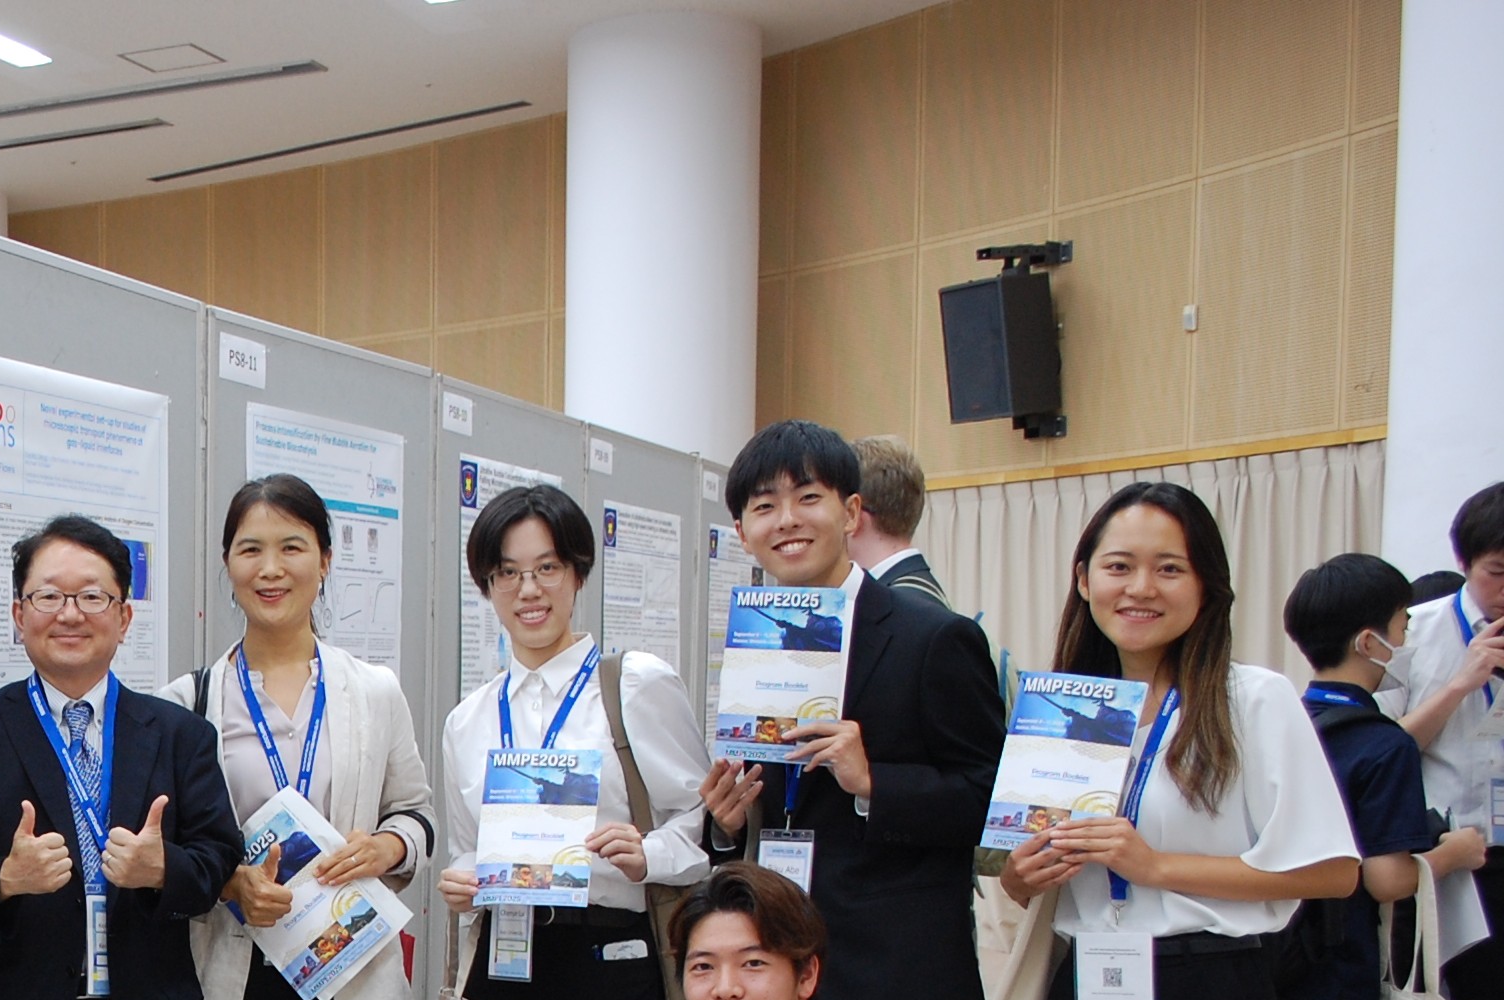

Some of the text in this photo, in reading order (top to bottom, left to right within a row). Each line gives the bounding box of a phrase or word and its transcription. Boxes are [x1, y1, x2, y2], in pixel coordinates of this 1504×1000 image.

[229, 349, 257, 372] PS8-11
[737, 591, 821, 608] MMPE2025
[1023, 677, 1115, 700] MMPE2025
[493, 752, 577, 768] MMPE2025
[245, 829, 278, 862] 2025
